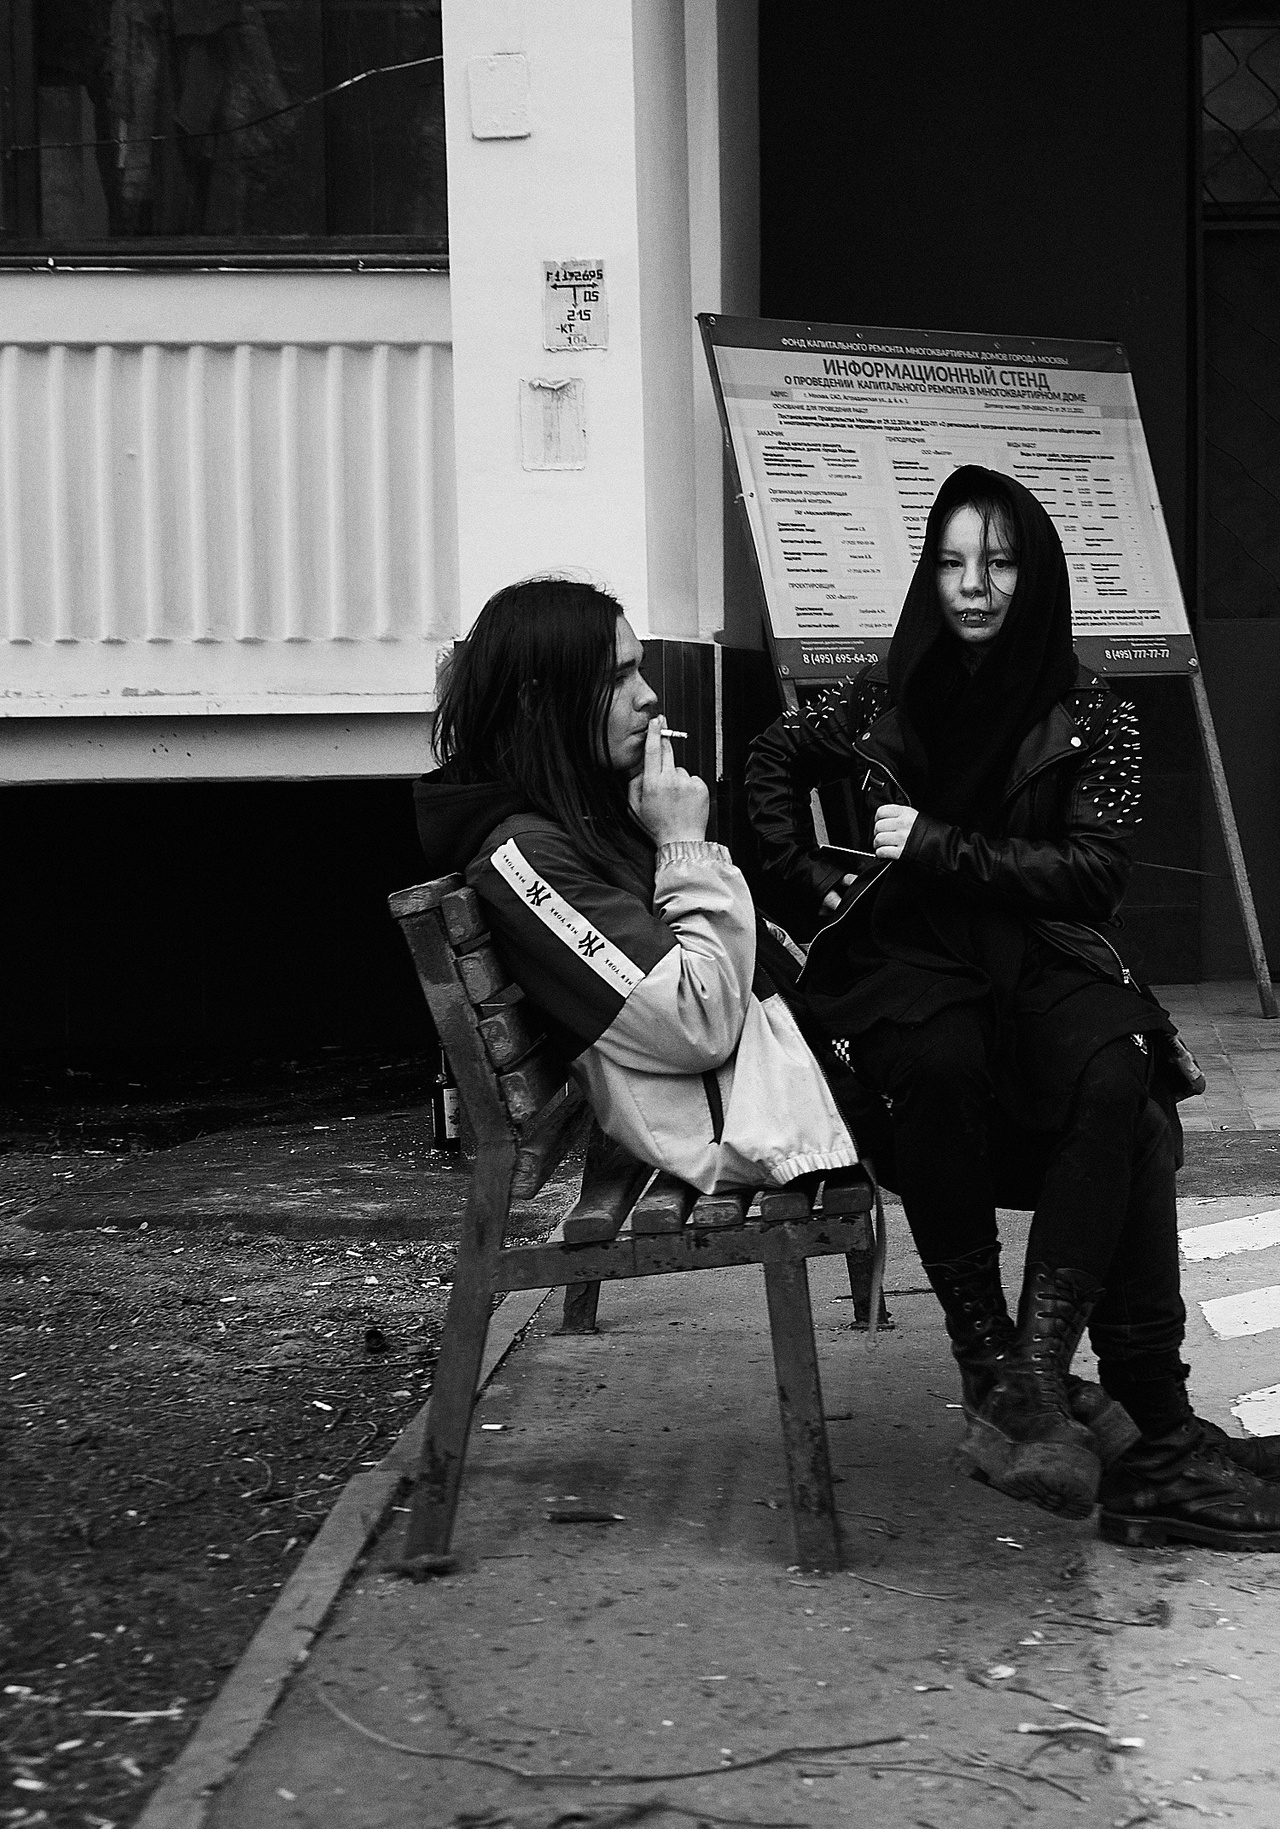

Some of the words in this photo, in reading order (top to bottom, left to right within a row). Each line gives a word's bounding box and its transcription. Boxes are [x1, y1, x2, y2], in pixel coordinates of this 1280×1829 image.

[781, 337, 807, 349] ФОНД
[807, 339, 868, 351] КАПИТАЛЬНОГО
[869, 344, 905, 354] РЕМОНТА
[823, 358, 997, 386] ИНФОРМАЦИОННЫЙ
[1000, 370, 1050, 391] СТЕНД
[784, 375, 792, 385] О
[793, 376, 854, 389] ПРОВЕДЕНИИ
[857, 379, 926, 393] КАПИТАЛЬНОГО
[928, 385, 968, 395] РЕМОНТА
[969, 387, 976, 395] В
[977, 387, 1061, 401] МНОГОКВАРТИРНОМ
[1062, 392, 1087, 402] ДОМЕ
[803, 653, 809, 663] 8
[811, 653, 834, 665] (495)
[835, 653, 878, 663] 695-64-20
[1105, 649, 1111, 659] 8
[1112, 649, 1132, 660] (495)
[1133, 649, 1169, 658] 777-77-77
